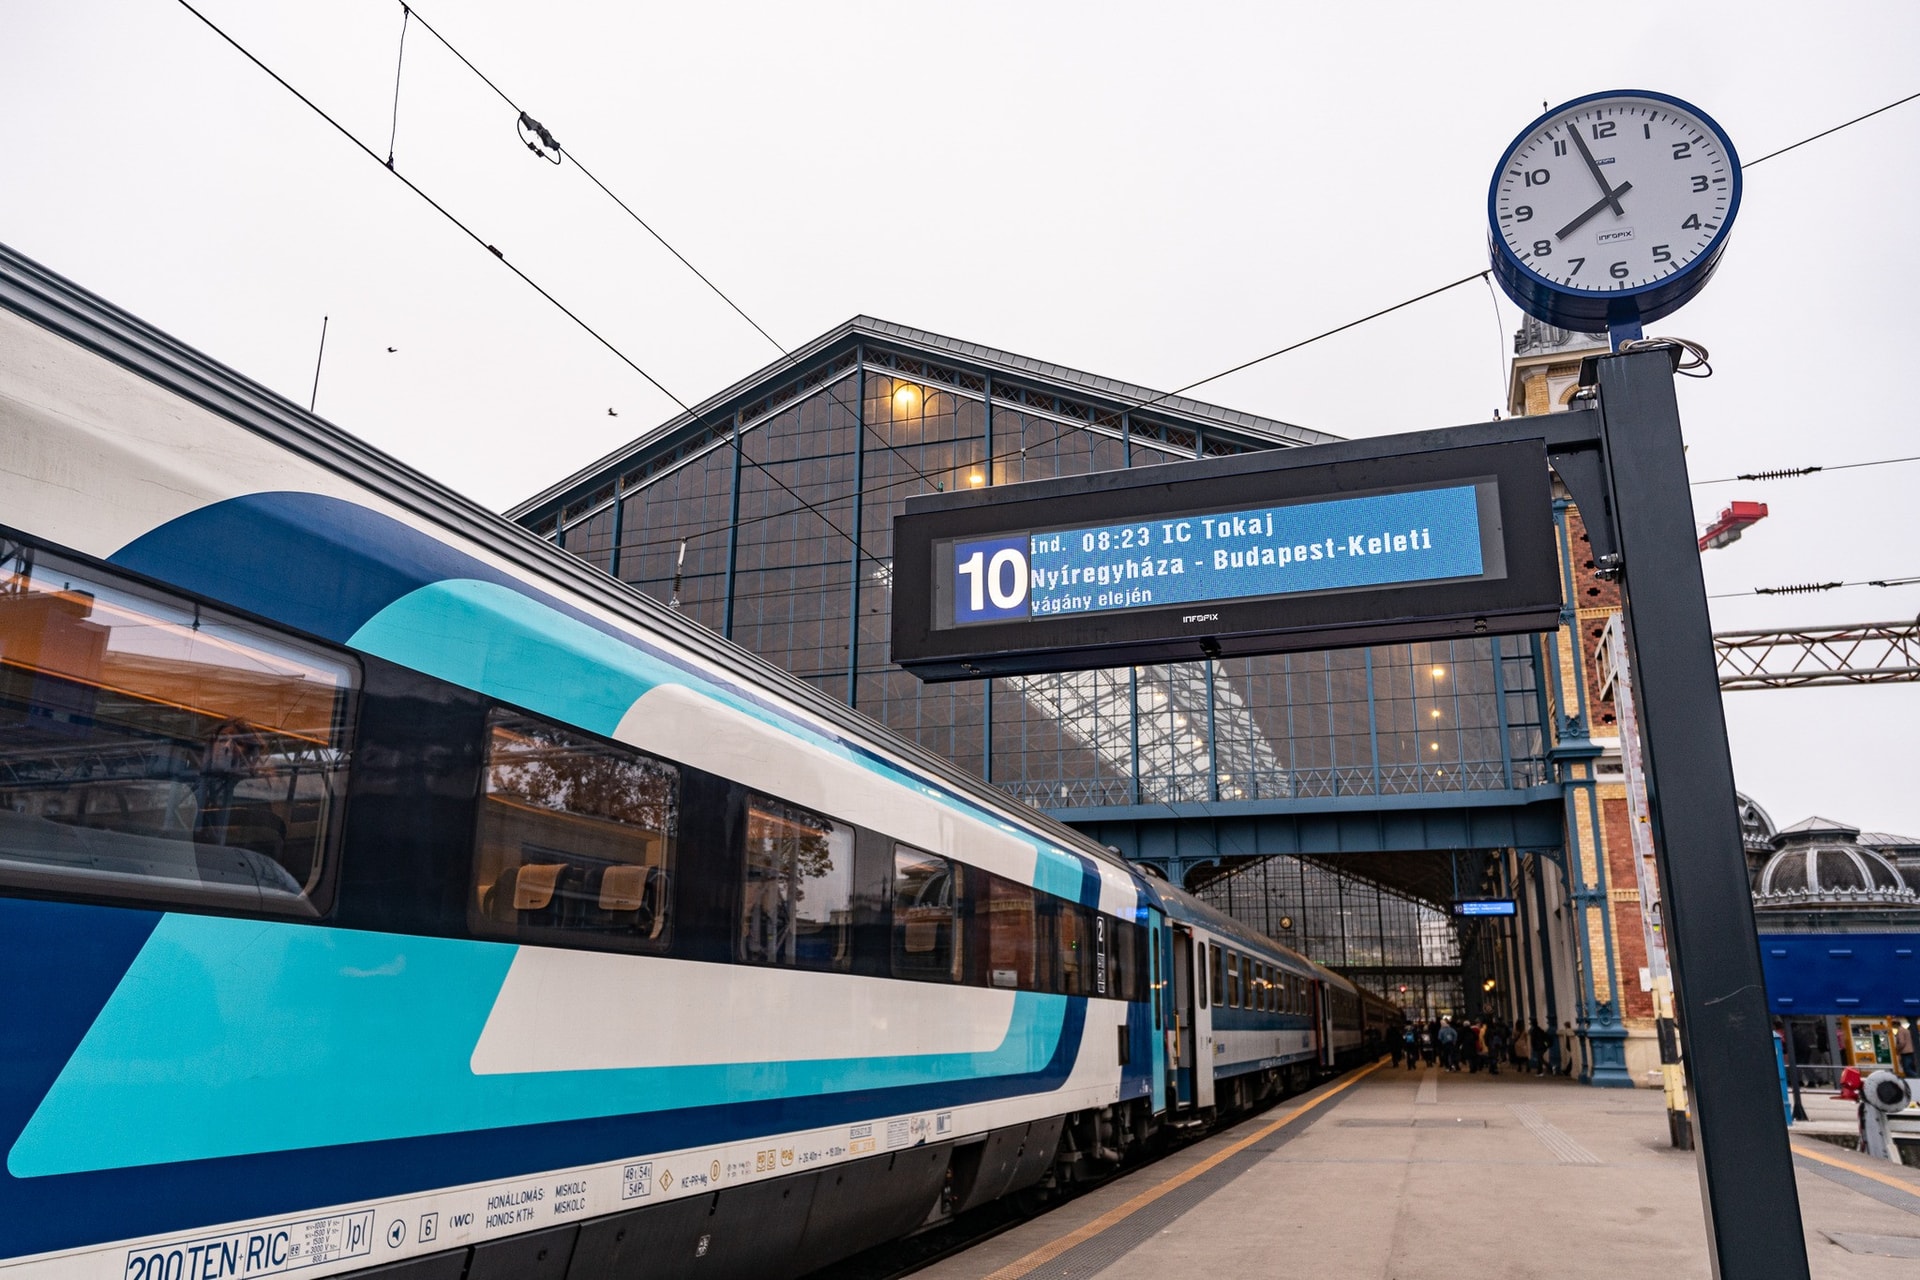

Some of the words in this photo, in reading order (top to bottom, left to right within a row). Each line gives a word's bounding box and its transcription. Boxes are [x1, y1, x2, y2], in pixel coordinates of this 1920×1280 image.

[1592, 121, 1617, 140] 12
[1644, 123, 1651, 140] 1
[1553, 139, 1567, 157] 11
[1672, 142, 1692, 160] 2
[1524, 168, 1551, 187] 10
[1690, 175, 1710, 193] 3
[1514, 205, 1534, 223] 9
[1681, 213, 1702, 231] 4
[1598, 230, 1632, 241] INFOPIX
[1533, 239, 1552, 257] 8
[1652, 244, 1672, 263] 5
[1567, 258, 1586, 276] 7
[1609, 261, 1629, 279] 6
[1031, 537, 1067, 555] ind.
[1082, 526, 1151, 553] 08:23
[1162, 522, 1192, 545] IC
[1202, 512, 1274, 541] Tokaj
[1031, 555, 1185, 591] Nyíregyháza
[1213, 528, 1433, 572] Budapest-Keleti
[958, 548, 1029, 612] 10
[1031, 593, 1092, 614] vágány
[1098, 588, 1152, 608] elején
[1182, 612, 1219, 624] INFOPIX
[555, 1180, 587, 1198] MISKOLC
[486, 1211, 515, 1229] HONOS
[554, 1198, 586, 1216] MISKOLC
[424, 1219, 432, 1236] 6
